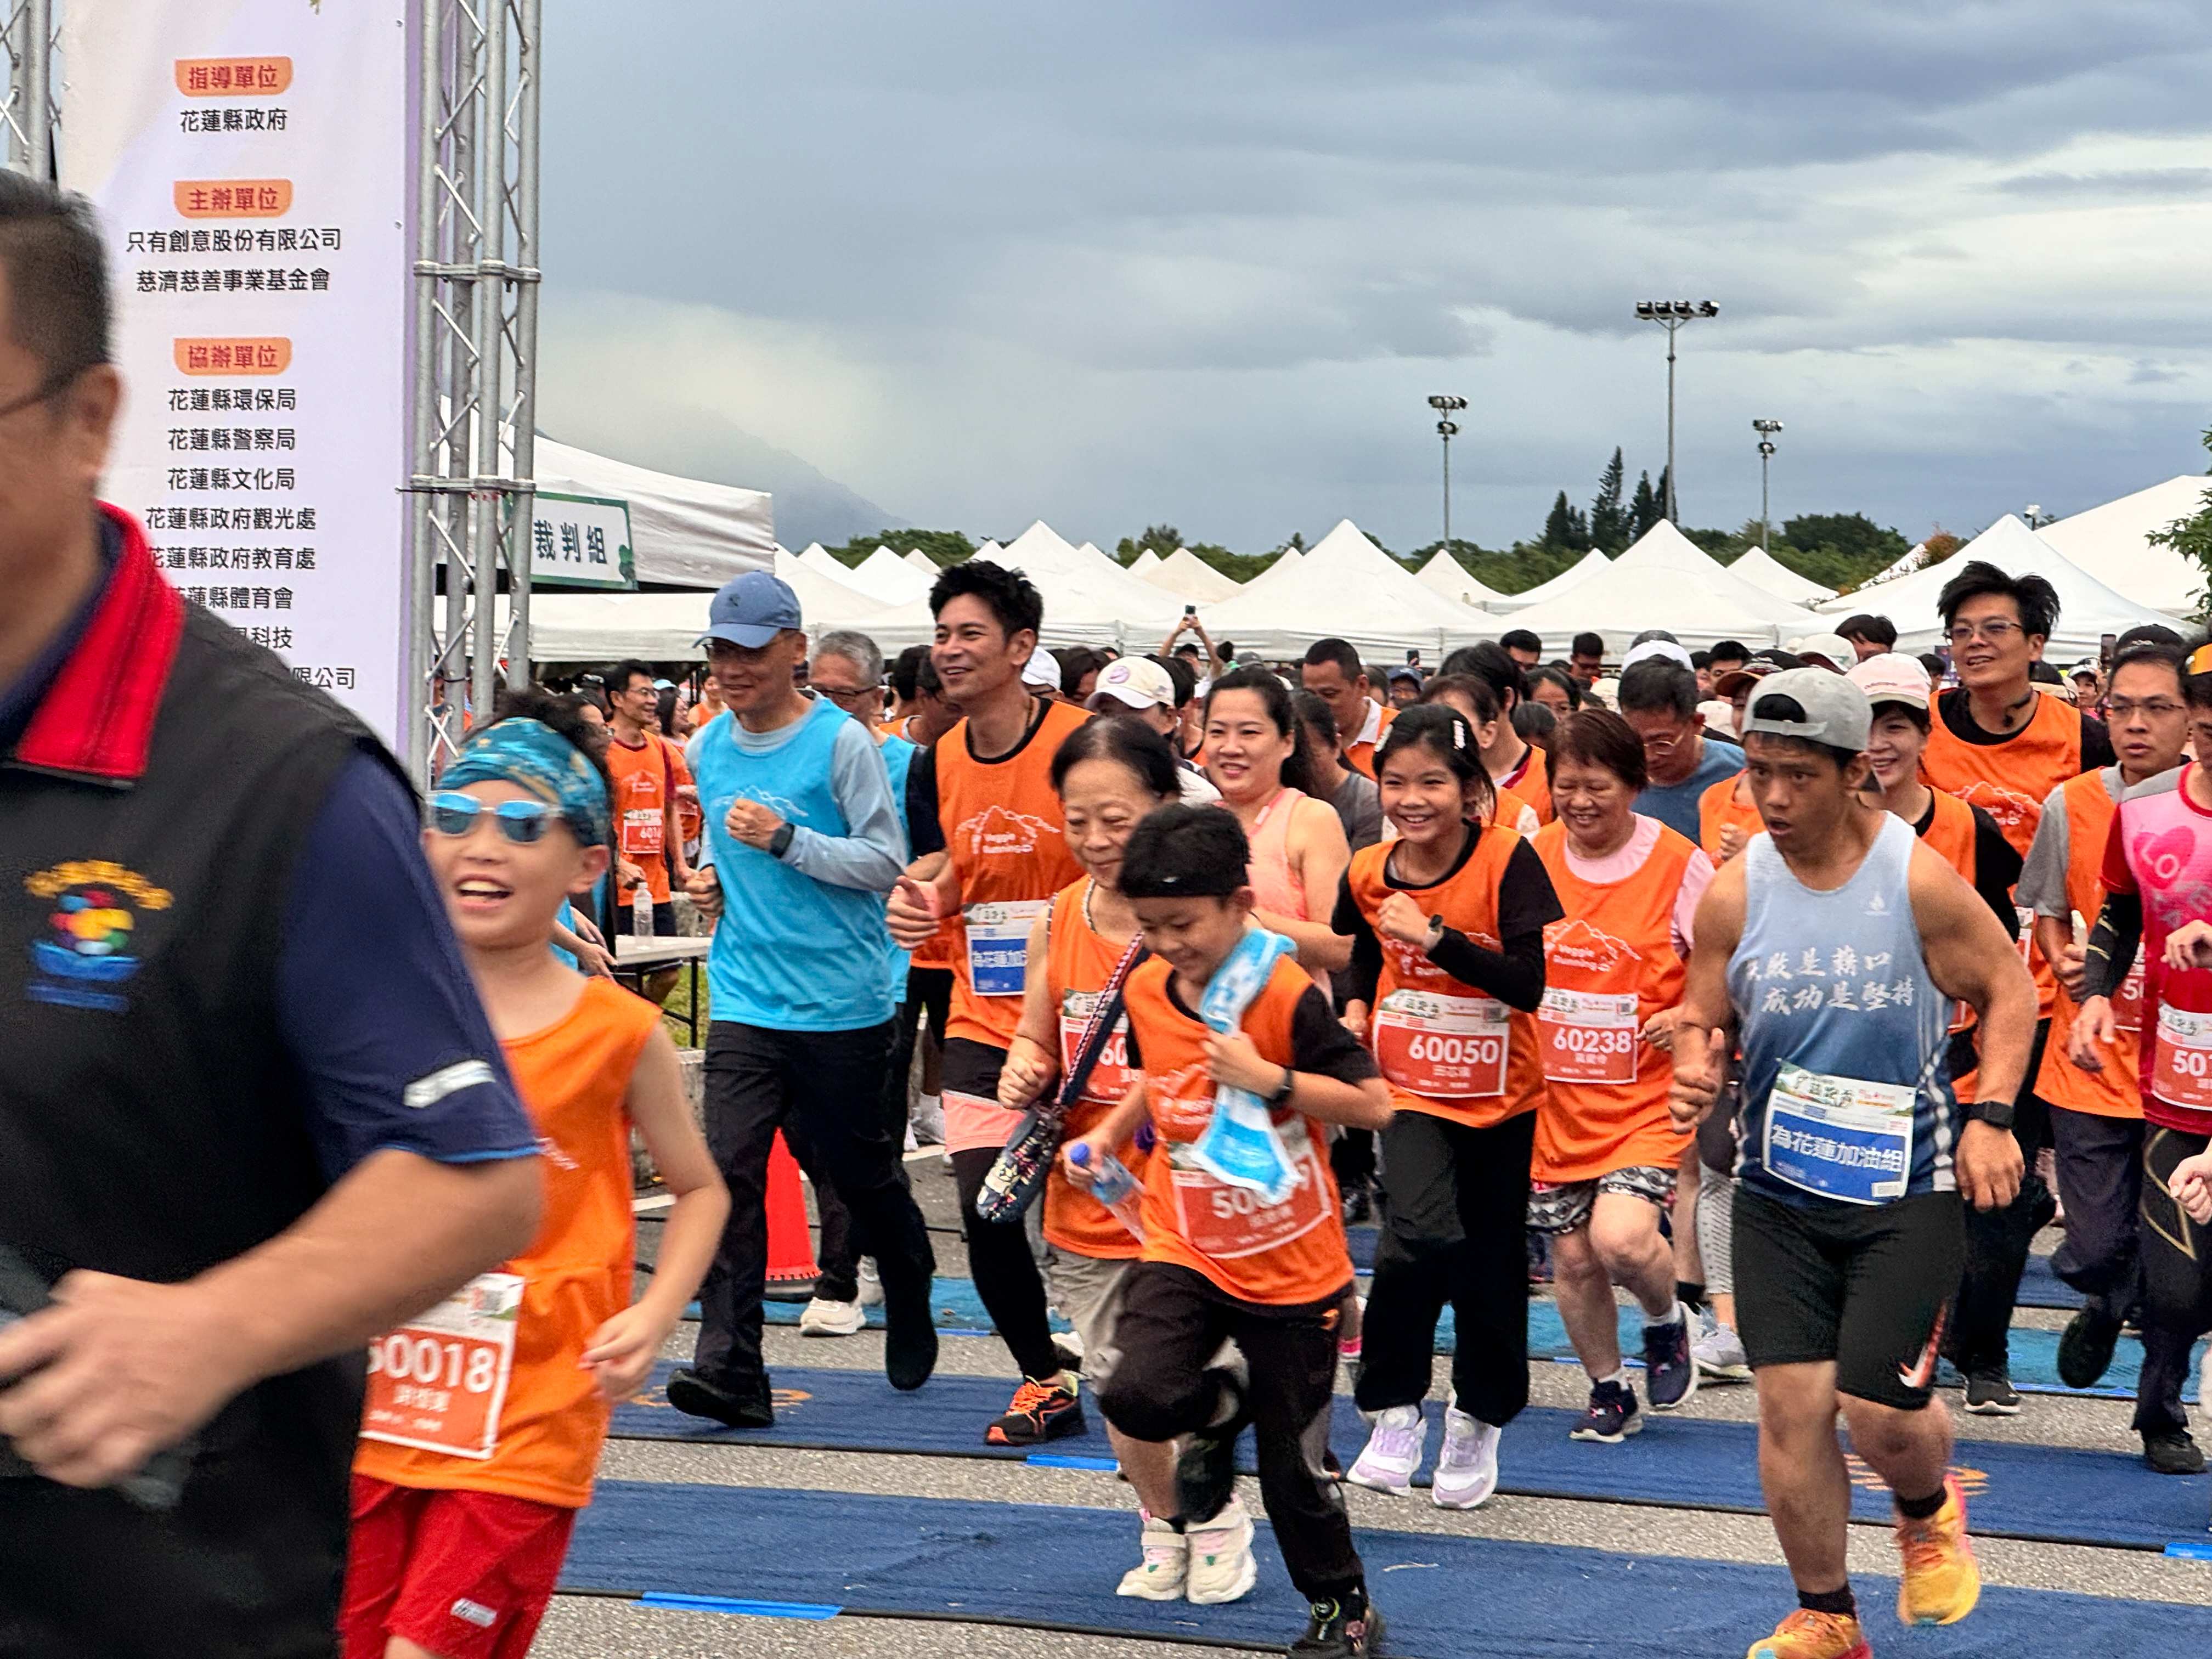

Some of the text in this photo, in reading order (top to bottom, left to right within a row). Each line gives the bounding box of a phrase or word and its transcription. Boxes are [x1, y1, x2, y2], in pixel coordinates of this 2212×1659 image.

[189, 64, 278, 89] 指導單位
[180, 108, 287, 133] 花蓮縣政府
[188, 187, 279, 211] 主辦單位
[126, 228, 341, 253] 只有創意股份有限公司
[136, 267, 331, 292] 慈濟慈善事業基金會
[189, 345, 278, 368] 協辦單位
[167, 388, 296, 411] 花蓮縣環保局
[167, 428, 296, 451] 花蓮縣警察局
[167, 467, 295, 490] 花蓮縣文化局
[146, 507, 317, 531] 花蓮縣政府觀光處
[533, 520, 607, 564] 裁判組
[1760, 975, 1915, 1015] 成功是堅持
[1408, 1035, 1500, 1064] 60050
[1553, 1027, 1632, 1054] 60238
[1772, 1124, 1904, 1172] 為花蓮加油組
